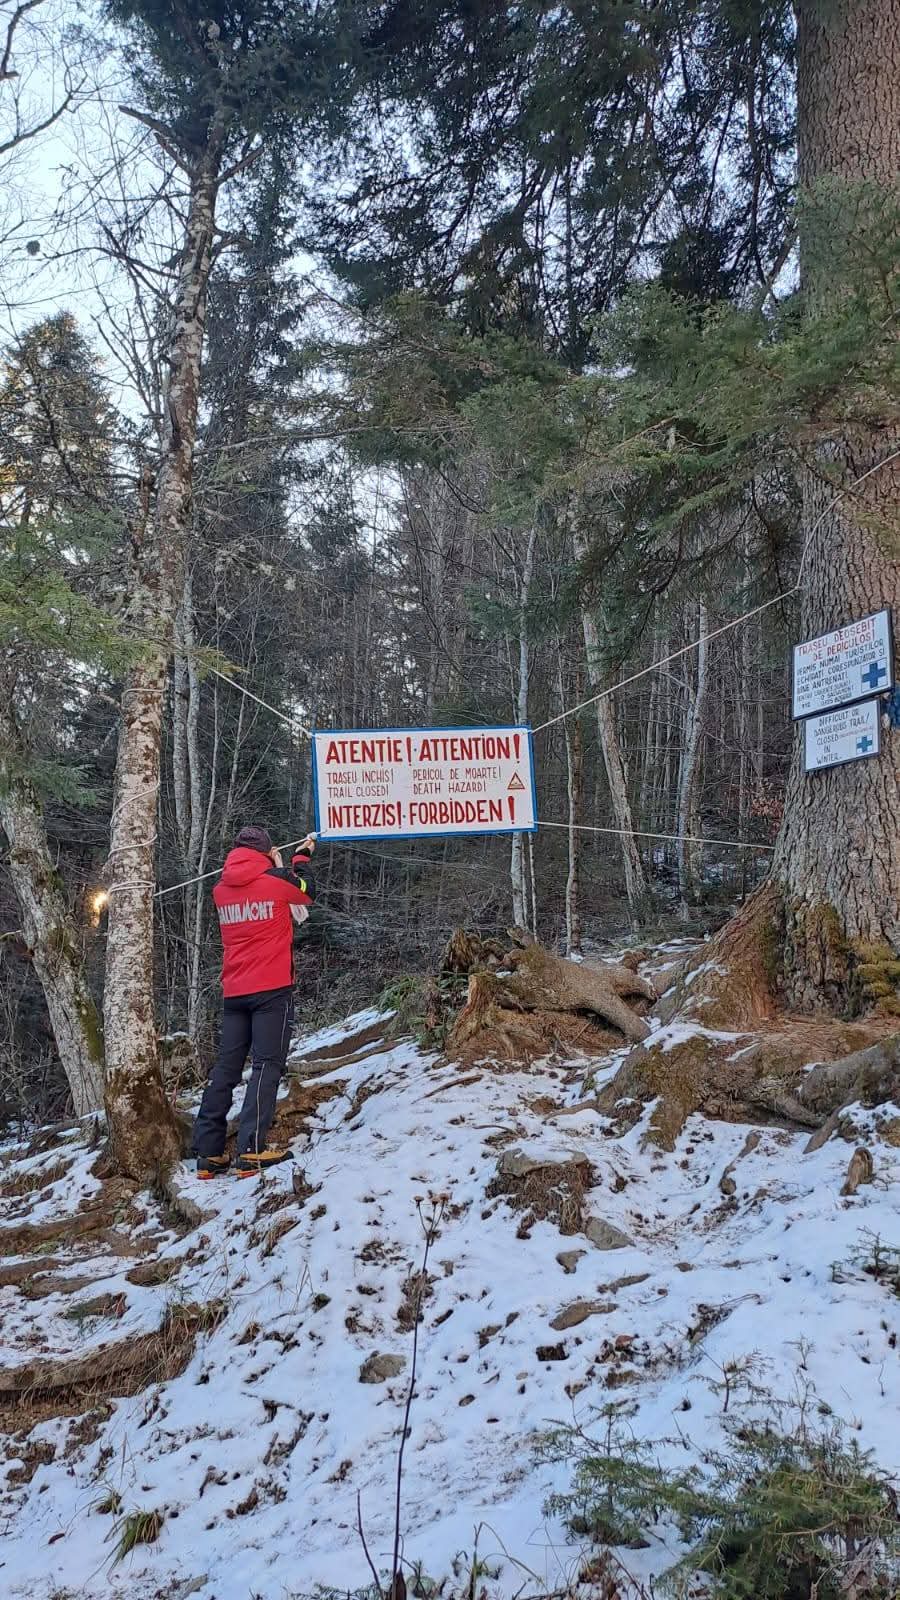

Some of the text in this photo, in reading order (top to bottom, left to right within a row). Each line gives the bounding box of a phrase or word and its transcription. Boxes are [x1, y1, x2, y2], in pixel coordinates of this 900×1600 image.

[799, 638, 828, 656] TRASEU
[816, 734, 839, 746] CLOSED
[419, 733, 520, 764] ATTENTION!
[823, 745, 831, 753] IN
[327, 771, 357, 785] TRASEU
[412, 765, 501, 780] PERICOL DE MOARTE!
[327, 784, 389, 799] TRAIL CLOSED!
[413, 781, 487, 795] DEATH HAZARD!
[409, 796, 515, 825] FORBIDDEN!
